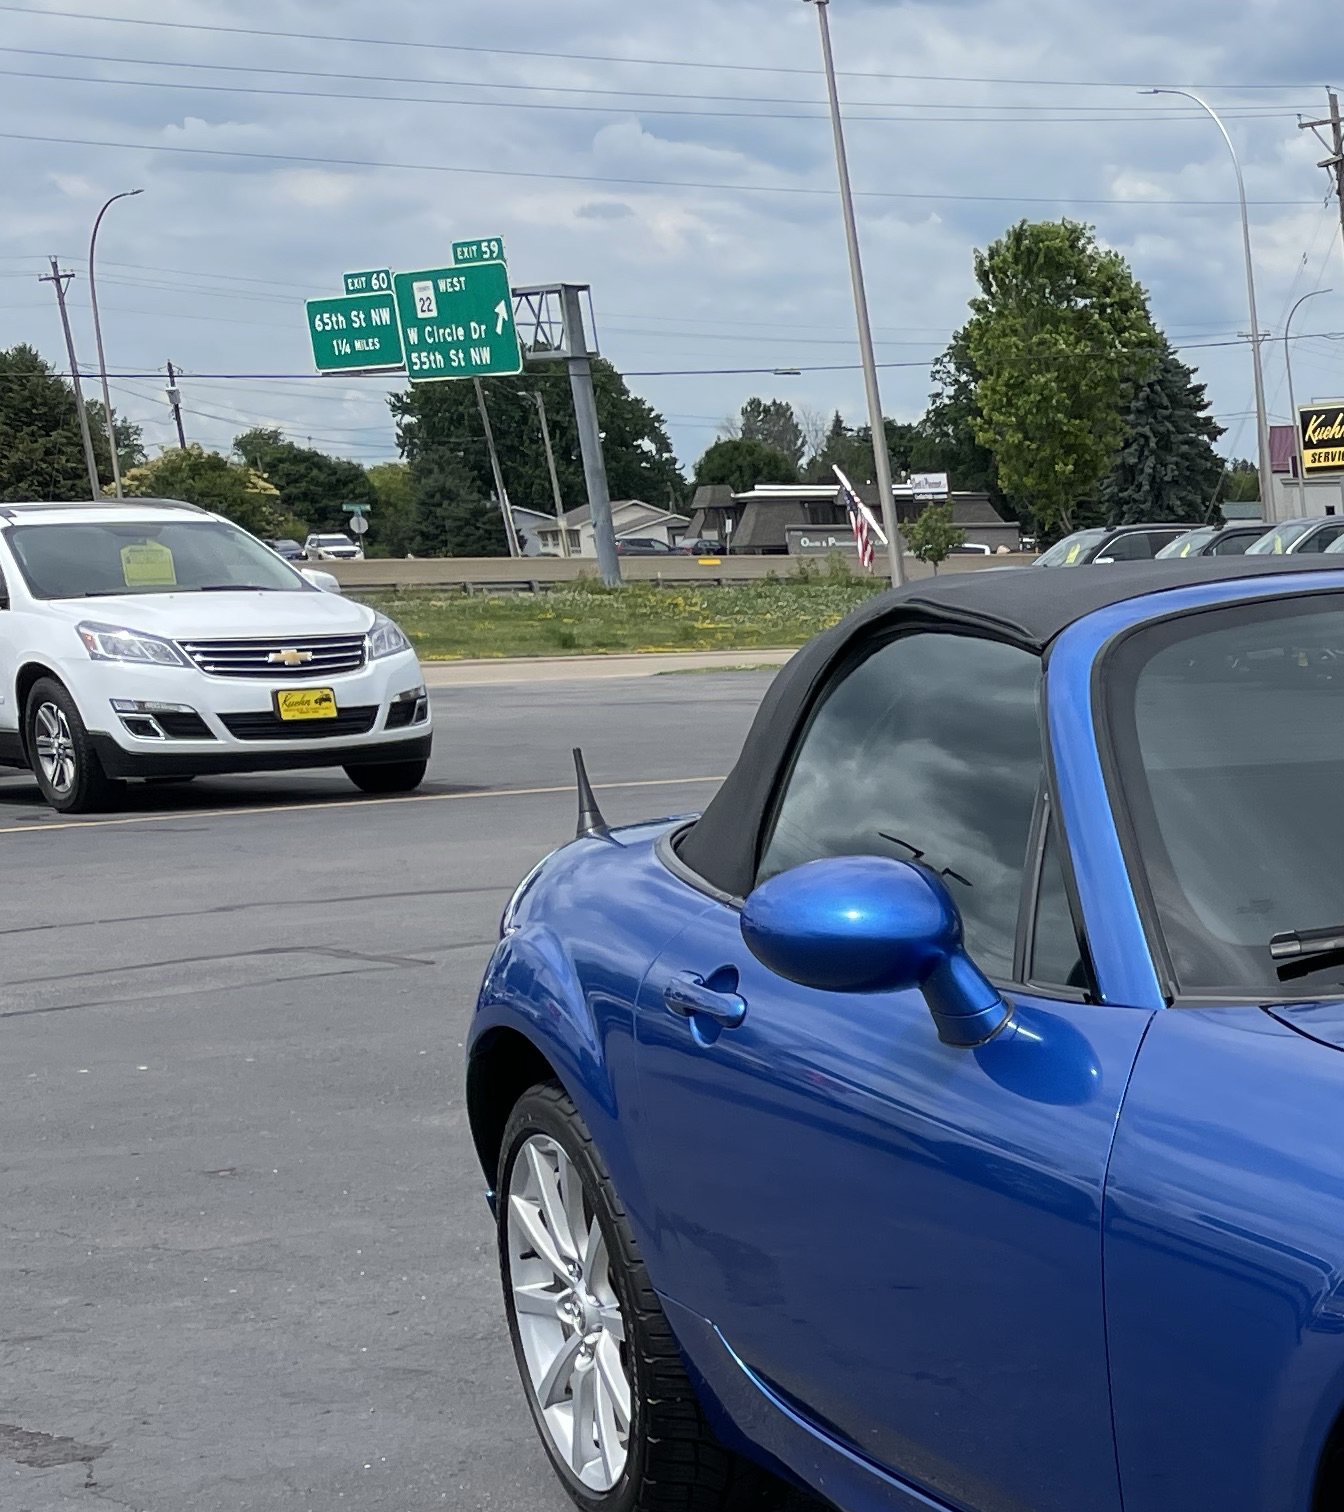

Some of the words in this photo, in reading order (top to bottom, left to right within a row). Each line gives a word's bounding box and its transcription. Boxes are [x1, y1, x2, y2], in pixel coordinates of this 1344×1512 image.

[456, 246, 478, 260] EXIT
[481, 240, 499, 259] 59
[347, 277, 366, 290] EXIT
[371, 272, 388, 290] 60
[437, 276, 466, 293] WEST
[419, 296, 433, 313] 22
[314, 312, 346, 332] 65th
[350, 310, 366, 328] St
[370, 307, 391, 326] NW
[407, 326, 418, 345] W
[424, 325, 464, 344] Circle
[470, 321, 487, 339] Dr
[354, 337, 380, 351] MILES
[411, 350, 444, 371] 55th
[449, 348, 466, 367] St
[470, 346, 491, 366] NW
